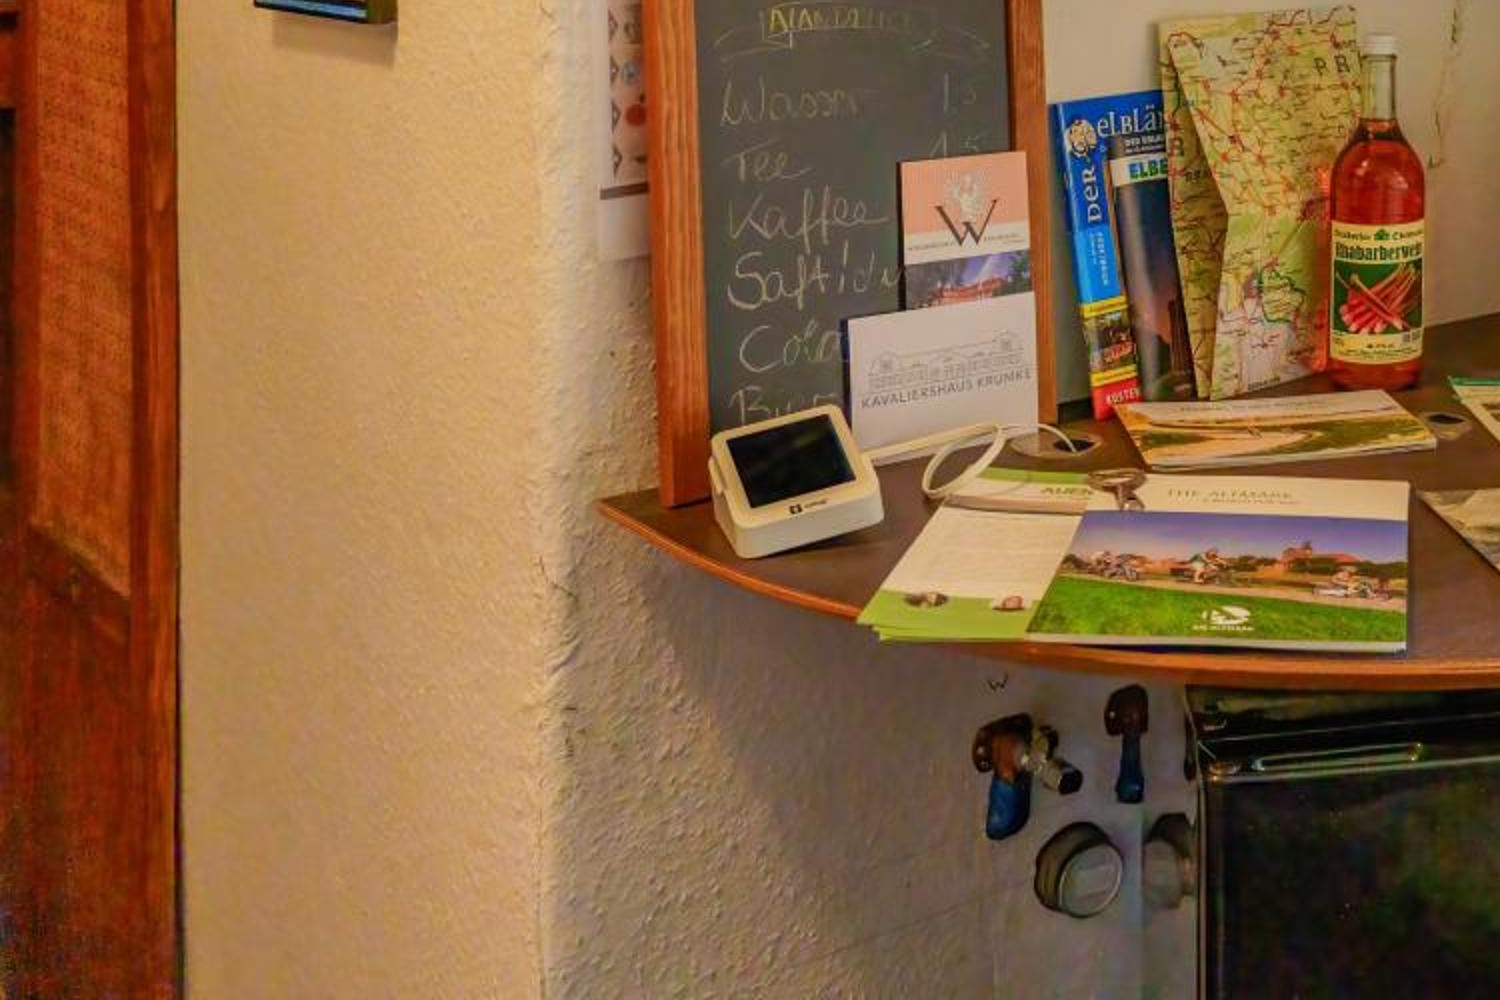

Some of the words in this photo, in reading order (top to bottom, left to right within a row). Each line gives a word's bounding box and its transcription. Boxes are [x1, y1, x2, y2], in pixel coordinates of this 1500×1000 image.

[735, 138, 812, 182] Tee
[728, 184, 888, 253] Kaffee
[935, 199, 998, 246] W
[861, 378, 973, 409] KAVALIERSHAUS
[977, 367, 1033, 389] KRUMKE
